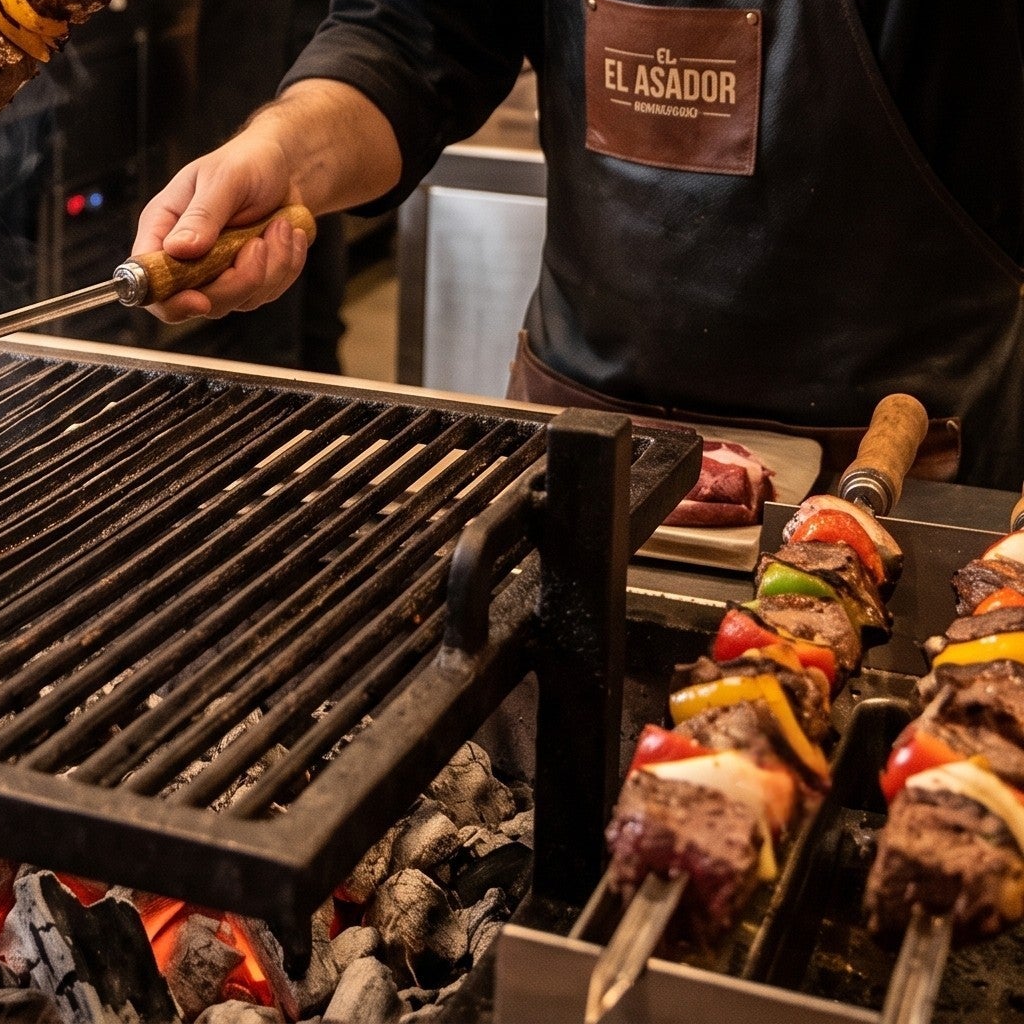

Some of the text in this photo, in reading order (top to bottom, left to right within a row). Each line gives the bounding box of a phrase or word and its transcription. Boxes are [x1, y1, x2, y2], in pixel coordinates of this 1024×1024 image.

[656, 47, 677, 65] EL
[604, 58, 737, 104] EL ASADOR
